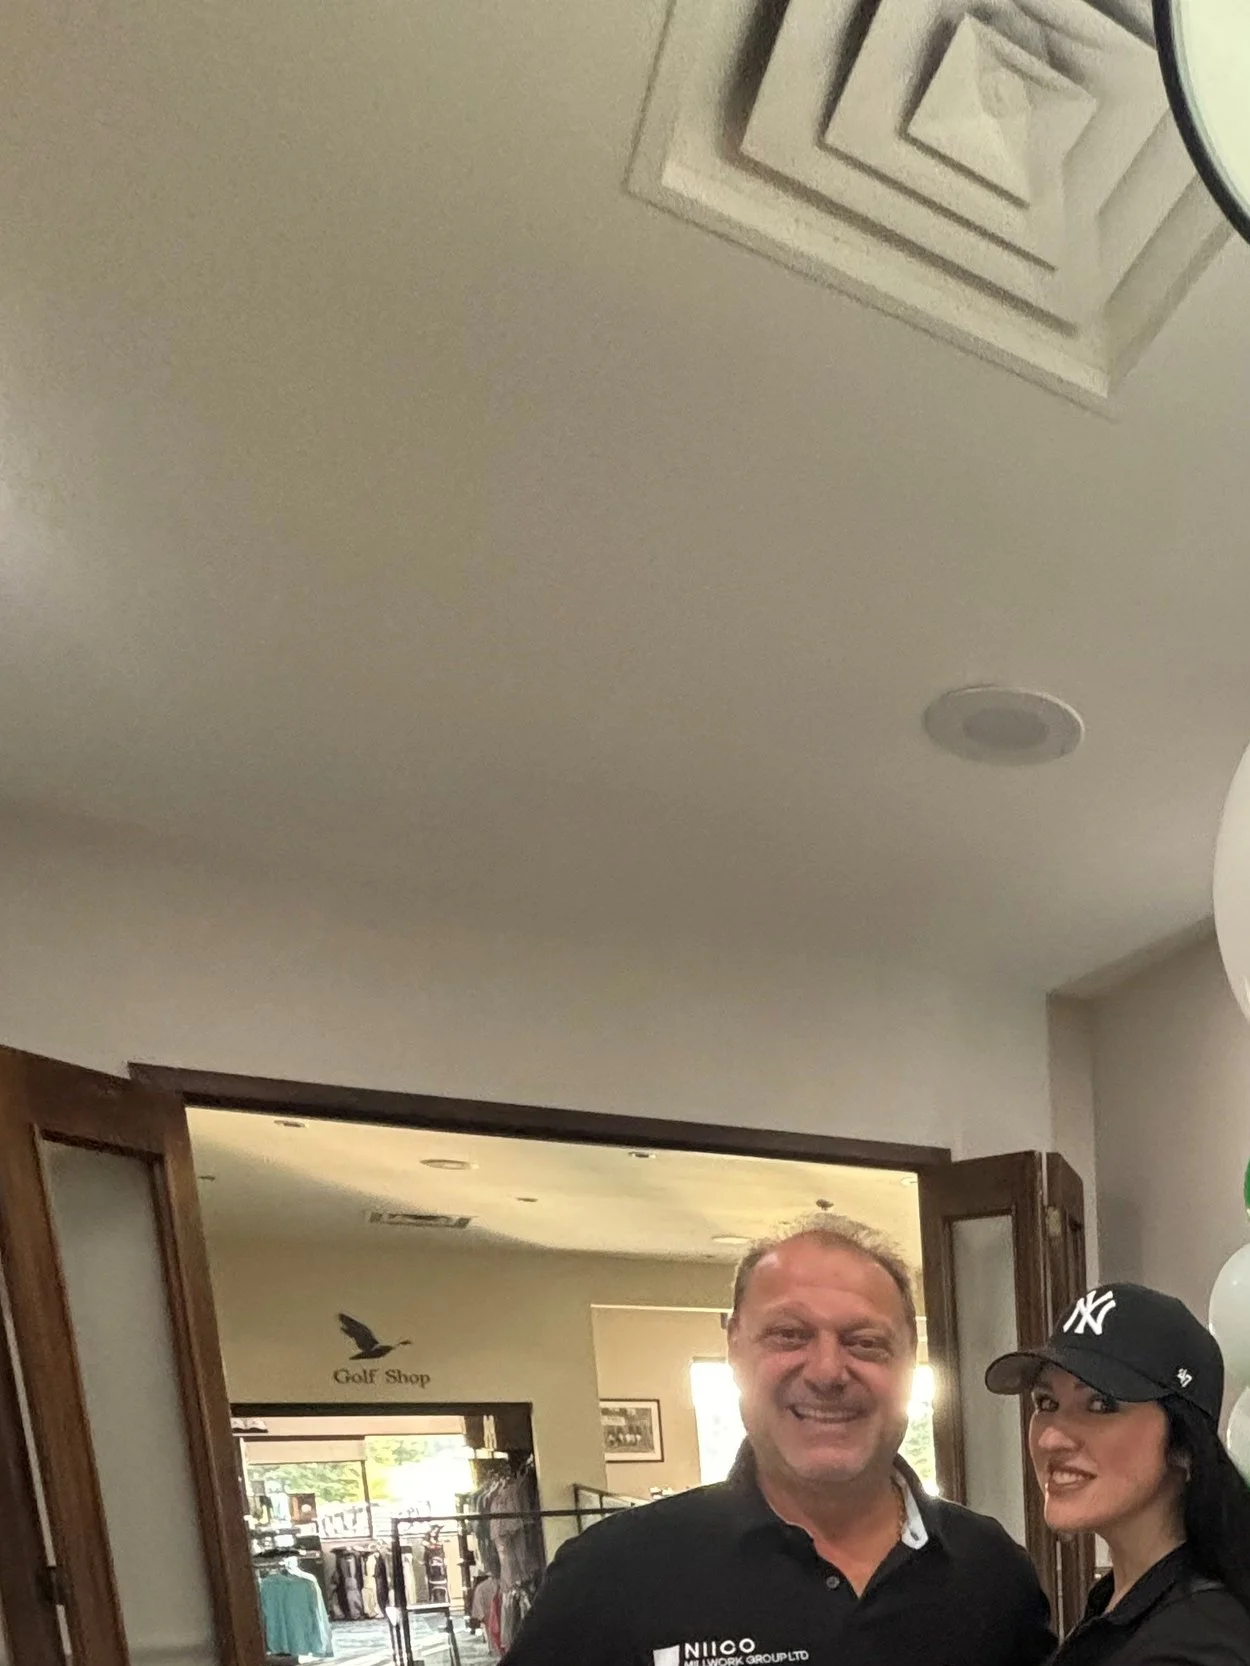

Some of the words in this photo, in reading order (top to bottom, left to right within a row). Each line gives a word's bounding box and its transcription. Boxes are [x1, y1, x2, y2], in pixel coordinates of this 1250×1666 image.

[1063, 1290, 1116, 1335] NY
[333, 1367, 379, 1386] Golf
[385, 1367, 431, 1389] Shop
[684, 1638, 755, 1659] NIICO
[746, 1652, 787, 1665] GROUP
[788, 1650, 809, 1662] LTD
